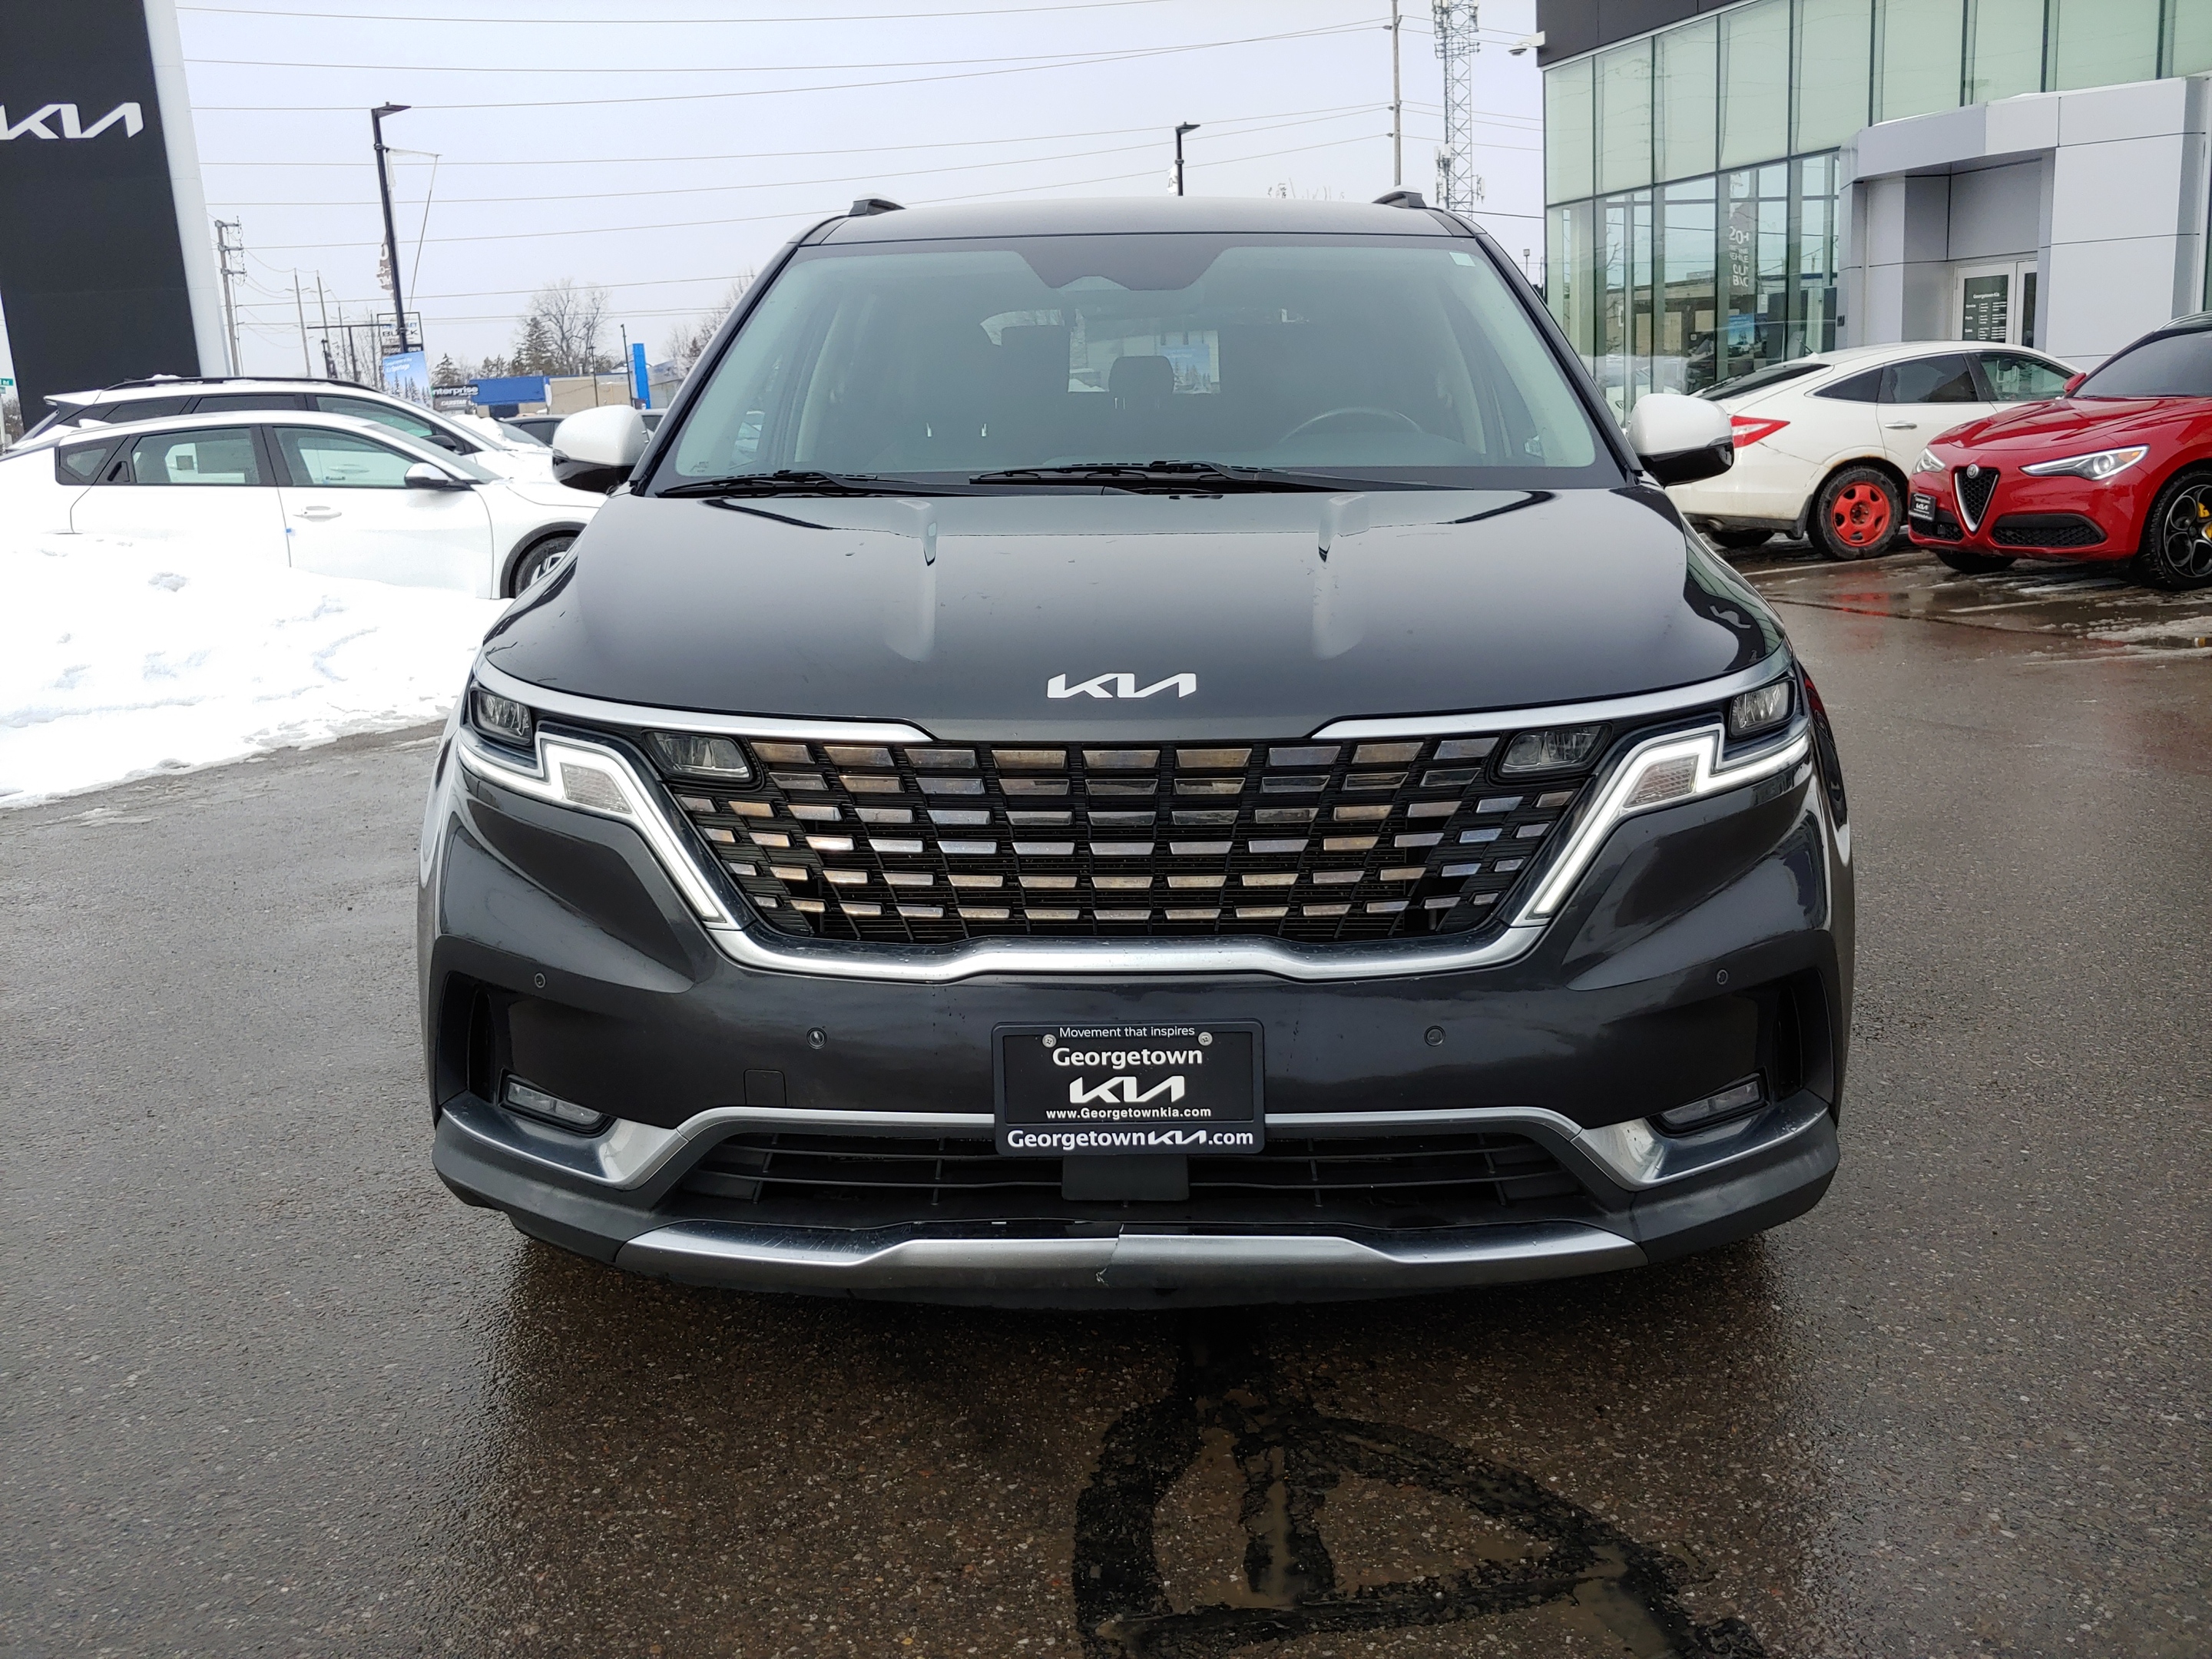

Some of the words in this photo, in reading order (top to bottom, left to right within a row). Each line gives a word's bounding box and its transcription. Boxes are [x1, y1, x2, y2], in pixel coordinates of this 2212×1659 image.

[0, 102, 144, 141] KIA
[1047, 673, 1197, 699] KIA
[1059, 1027, 1121, 1038] Movement
[1124, 1027, 1147, 1037] that
[1151, 1025, 1195, 1038] inspires
[1052, 1048, 1203, 1070] Georgetown
[1069, 1075, 1185, 1103] KIA
[1046, 1107, 1211, 1120] www.Georgetownkia.com
